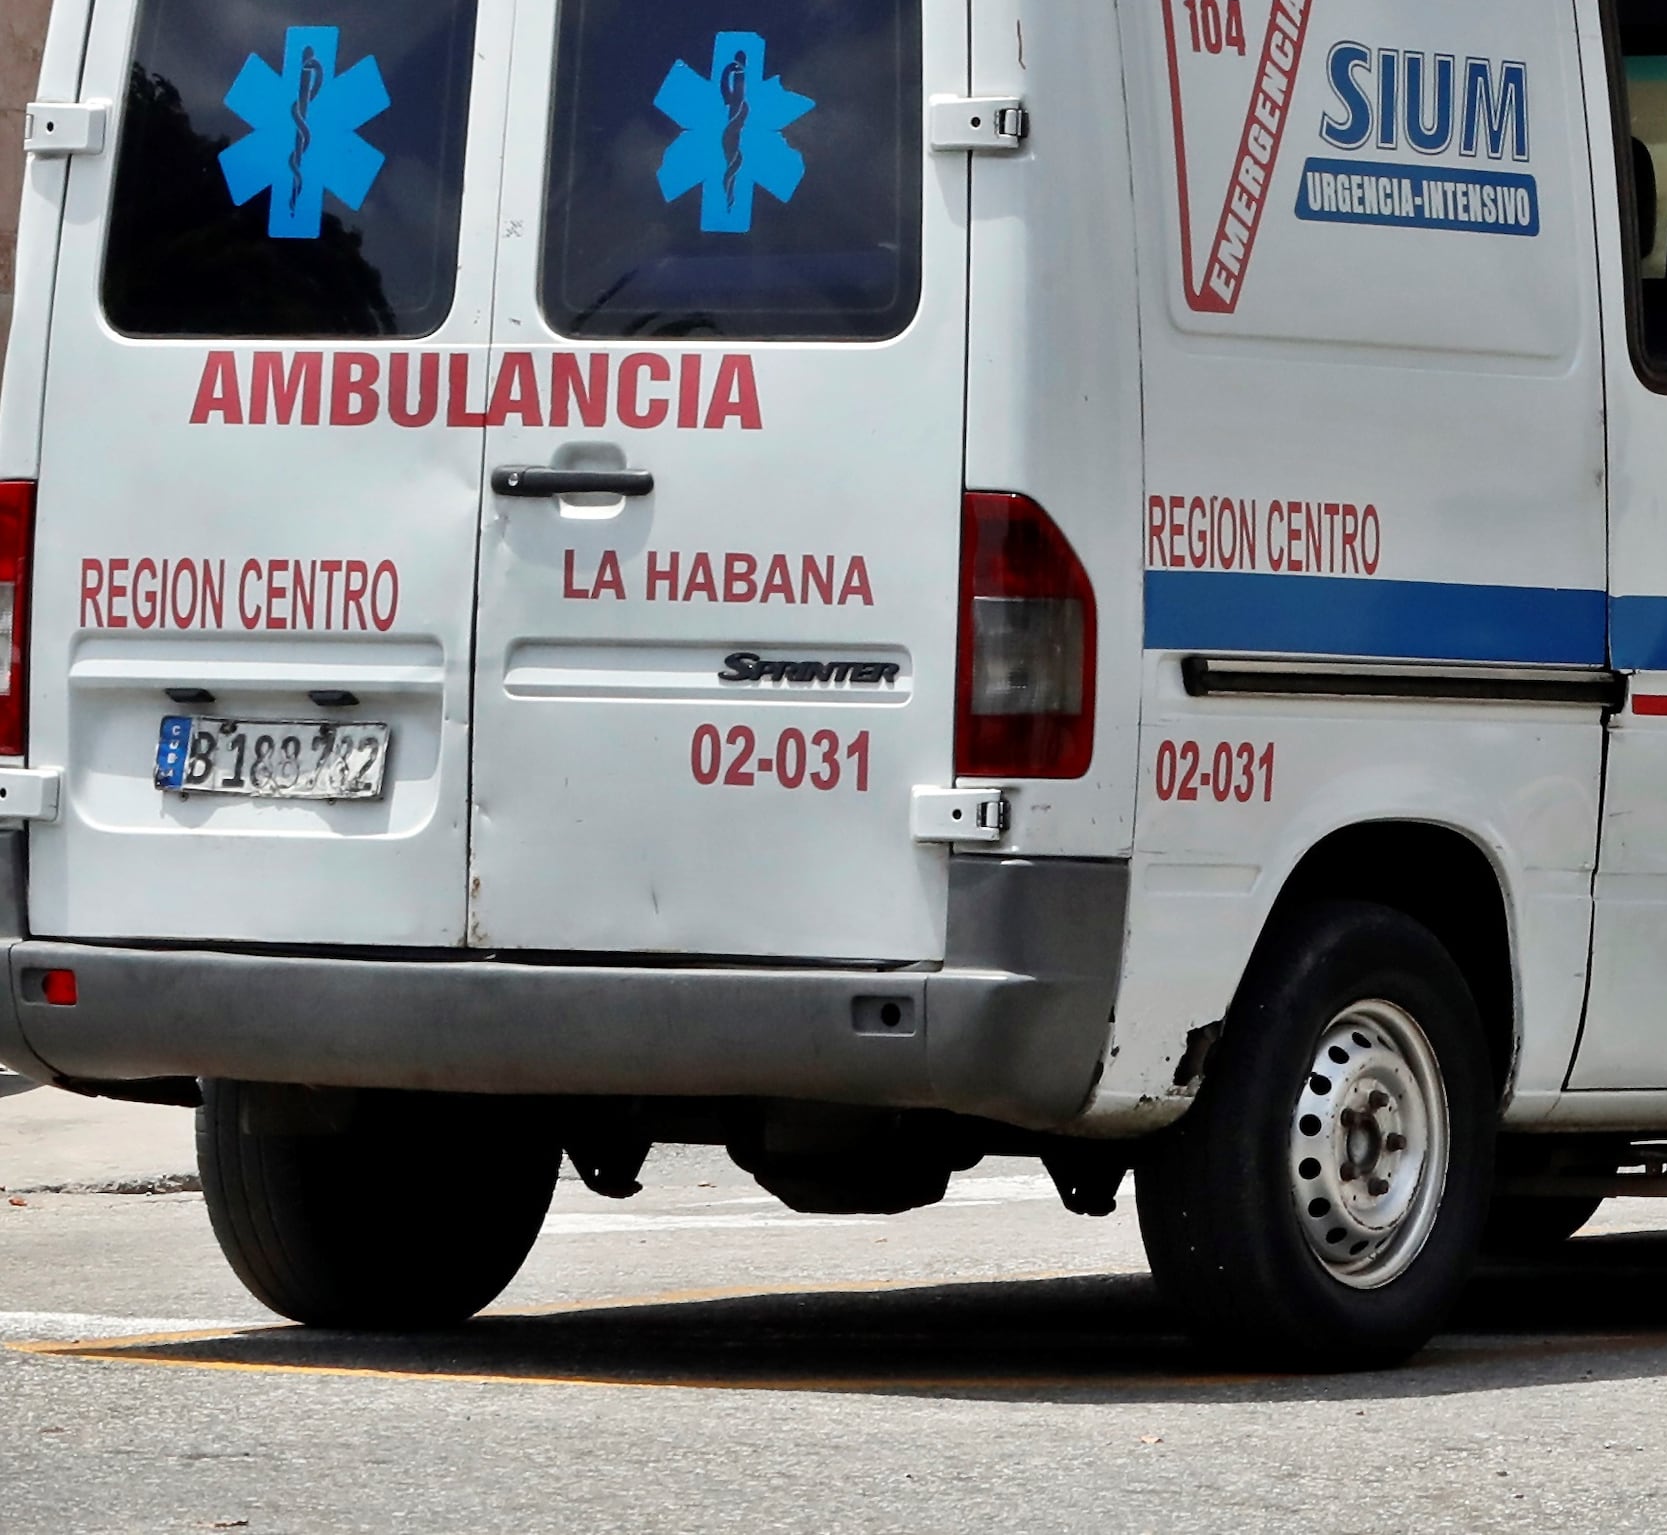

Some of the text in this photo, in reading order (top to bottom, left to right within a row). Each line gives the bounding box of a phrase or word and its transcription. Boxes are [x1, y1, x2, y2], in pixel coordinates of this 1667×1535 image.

[1319, 40, 1530, 163] SIUM
[1306, 171, 1530, 226] URGENCIA-INTENSIVO
[189, 351, 763, 430] AMBULANCIA
[1266, 500, 1382, 577] CENTRO
[79, 557, 400, 632] REGION CENTRO
[561, 549, 874, 607] LA HABANA
[691, 722, 871, 792] 02-031
[1156, 739, 1276, 804] 02-031
